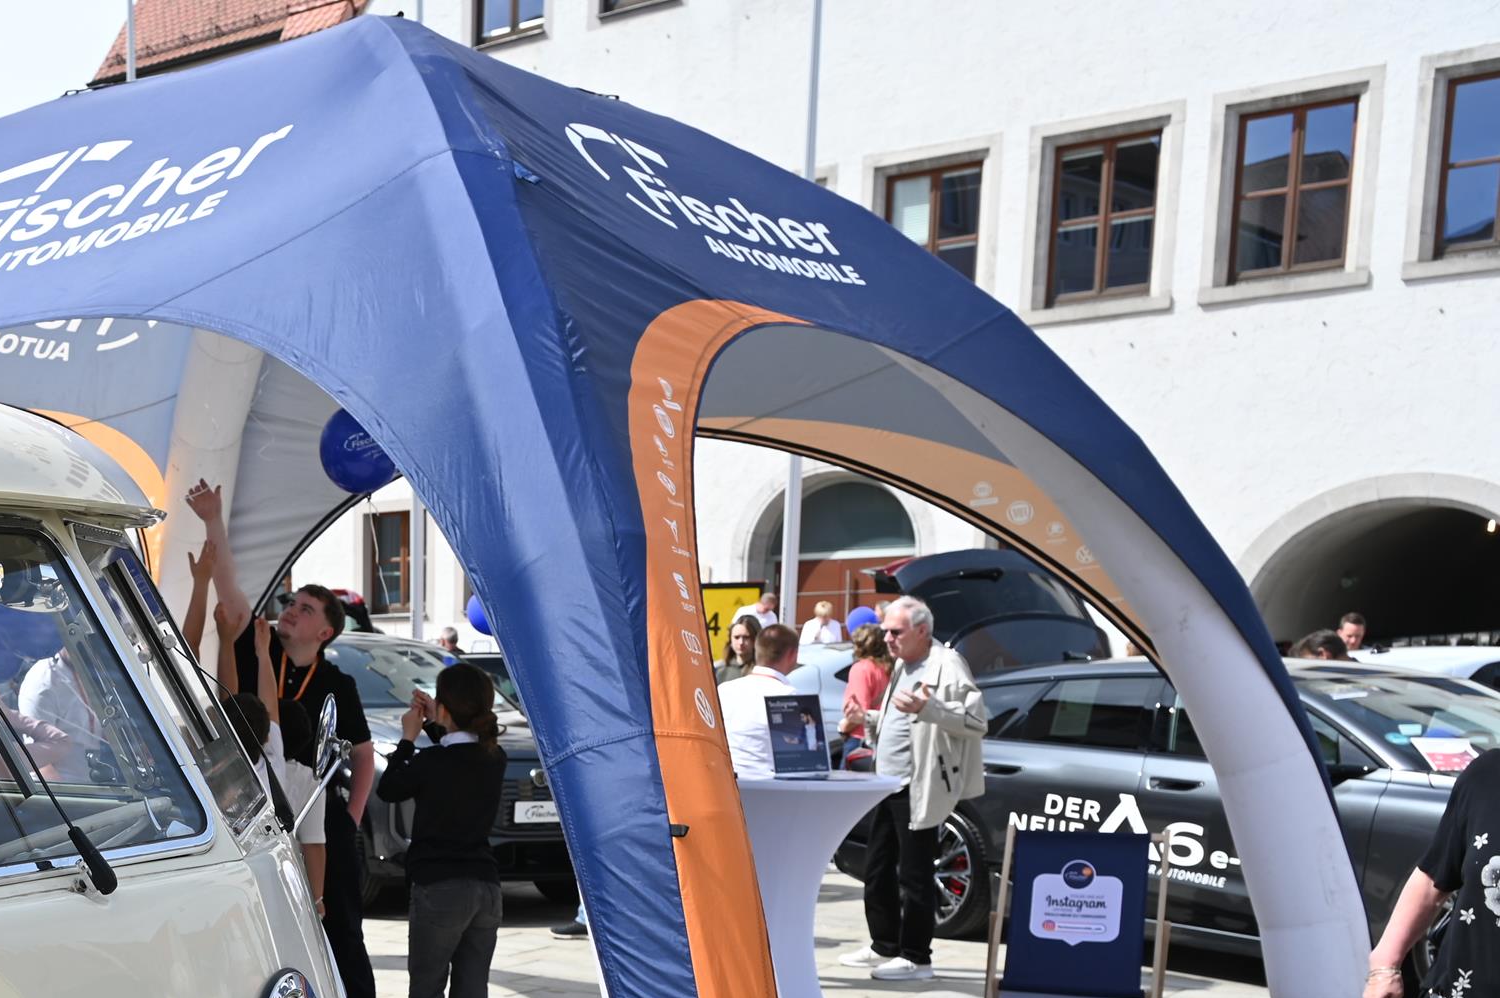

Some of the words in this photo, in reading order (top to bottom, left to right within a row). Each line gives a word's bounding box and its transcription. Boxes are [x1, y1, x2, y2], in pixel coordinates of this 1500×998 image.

[622, 165, 840, 256] Fischer
[704, 235, 867, 286] AUTOMOBILE
[1044, 793, 1101, 823] DER
[1045, 895, 1108, 913] Instagram
